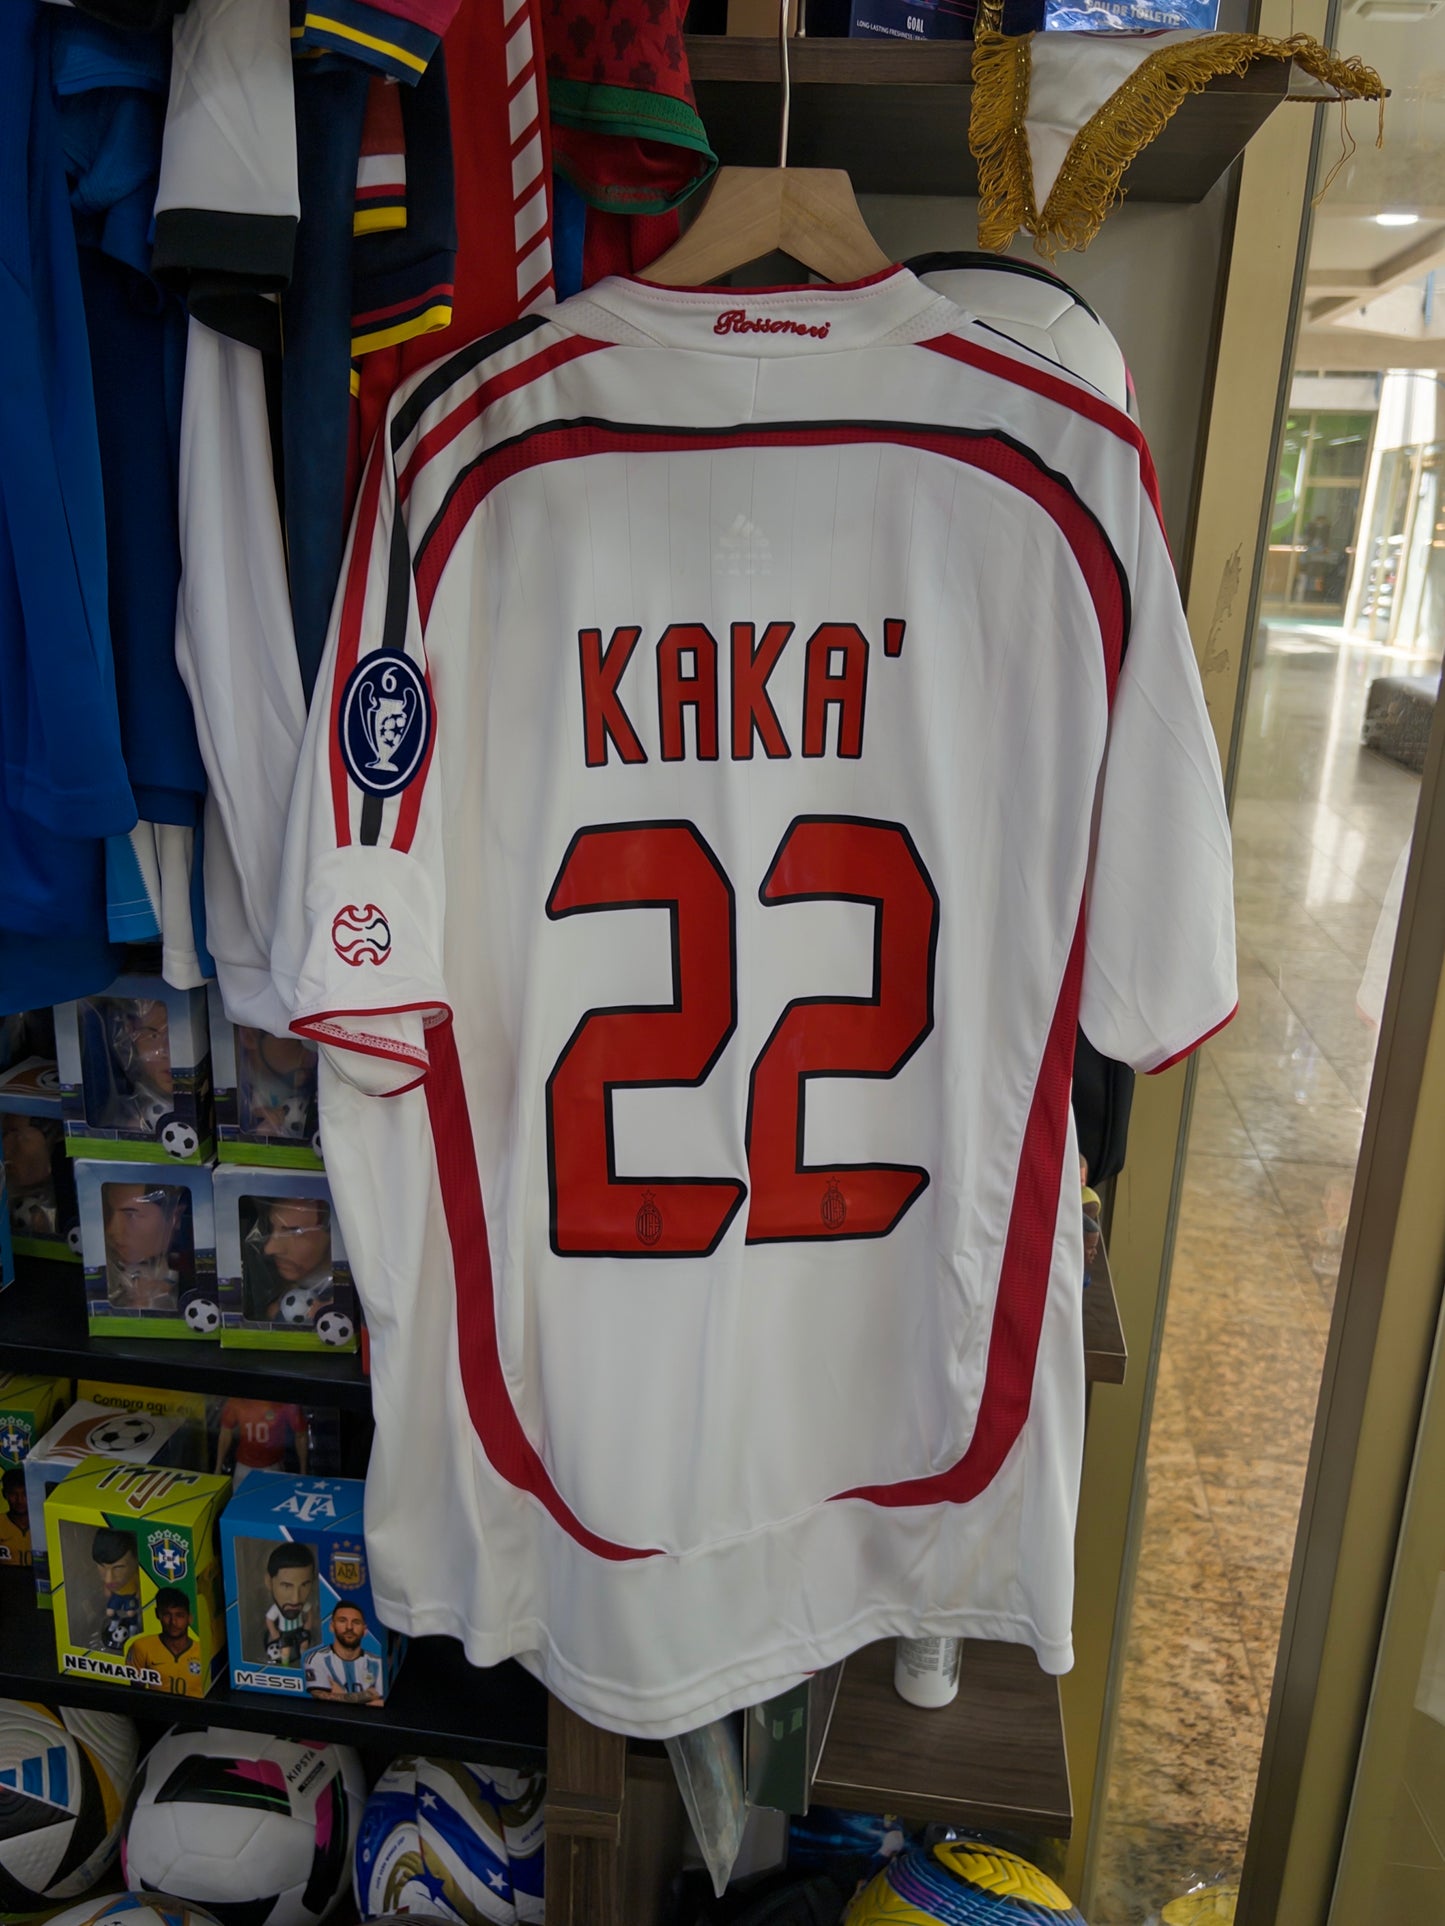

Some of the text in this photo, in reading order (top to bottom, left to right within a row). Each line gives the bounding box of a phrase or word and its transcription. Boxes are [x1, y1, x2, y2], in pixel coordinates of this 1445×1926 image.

[1112, 4, 1128, 17] DE
[906, 15, 924, 33] GOAL
[381, 666, 399, 693] 6
[577, 617, 907, 768] KAKA'
[545, 814, 940, 1258] 22
[93, 1393, 144, 1409] Compra
[245, 1421, 270, 1443] 10
[271, 1489, 337, 1522] AFA
[337, 1562, 358, 1579] AFA
[64, 1655, 161, 1684] NEYMAR JR
[168, 1675, 187, 1696] 10
[286, 1750, 317, 1783] KIPSTA
